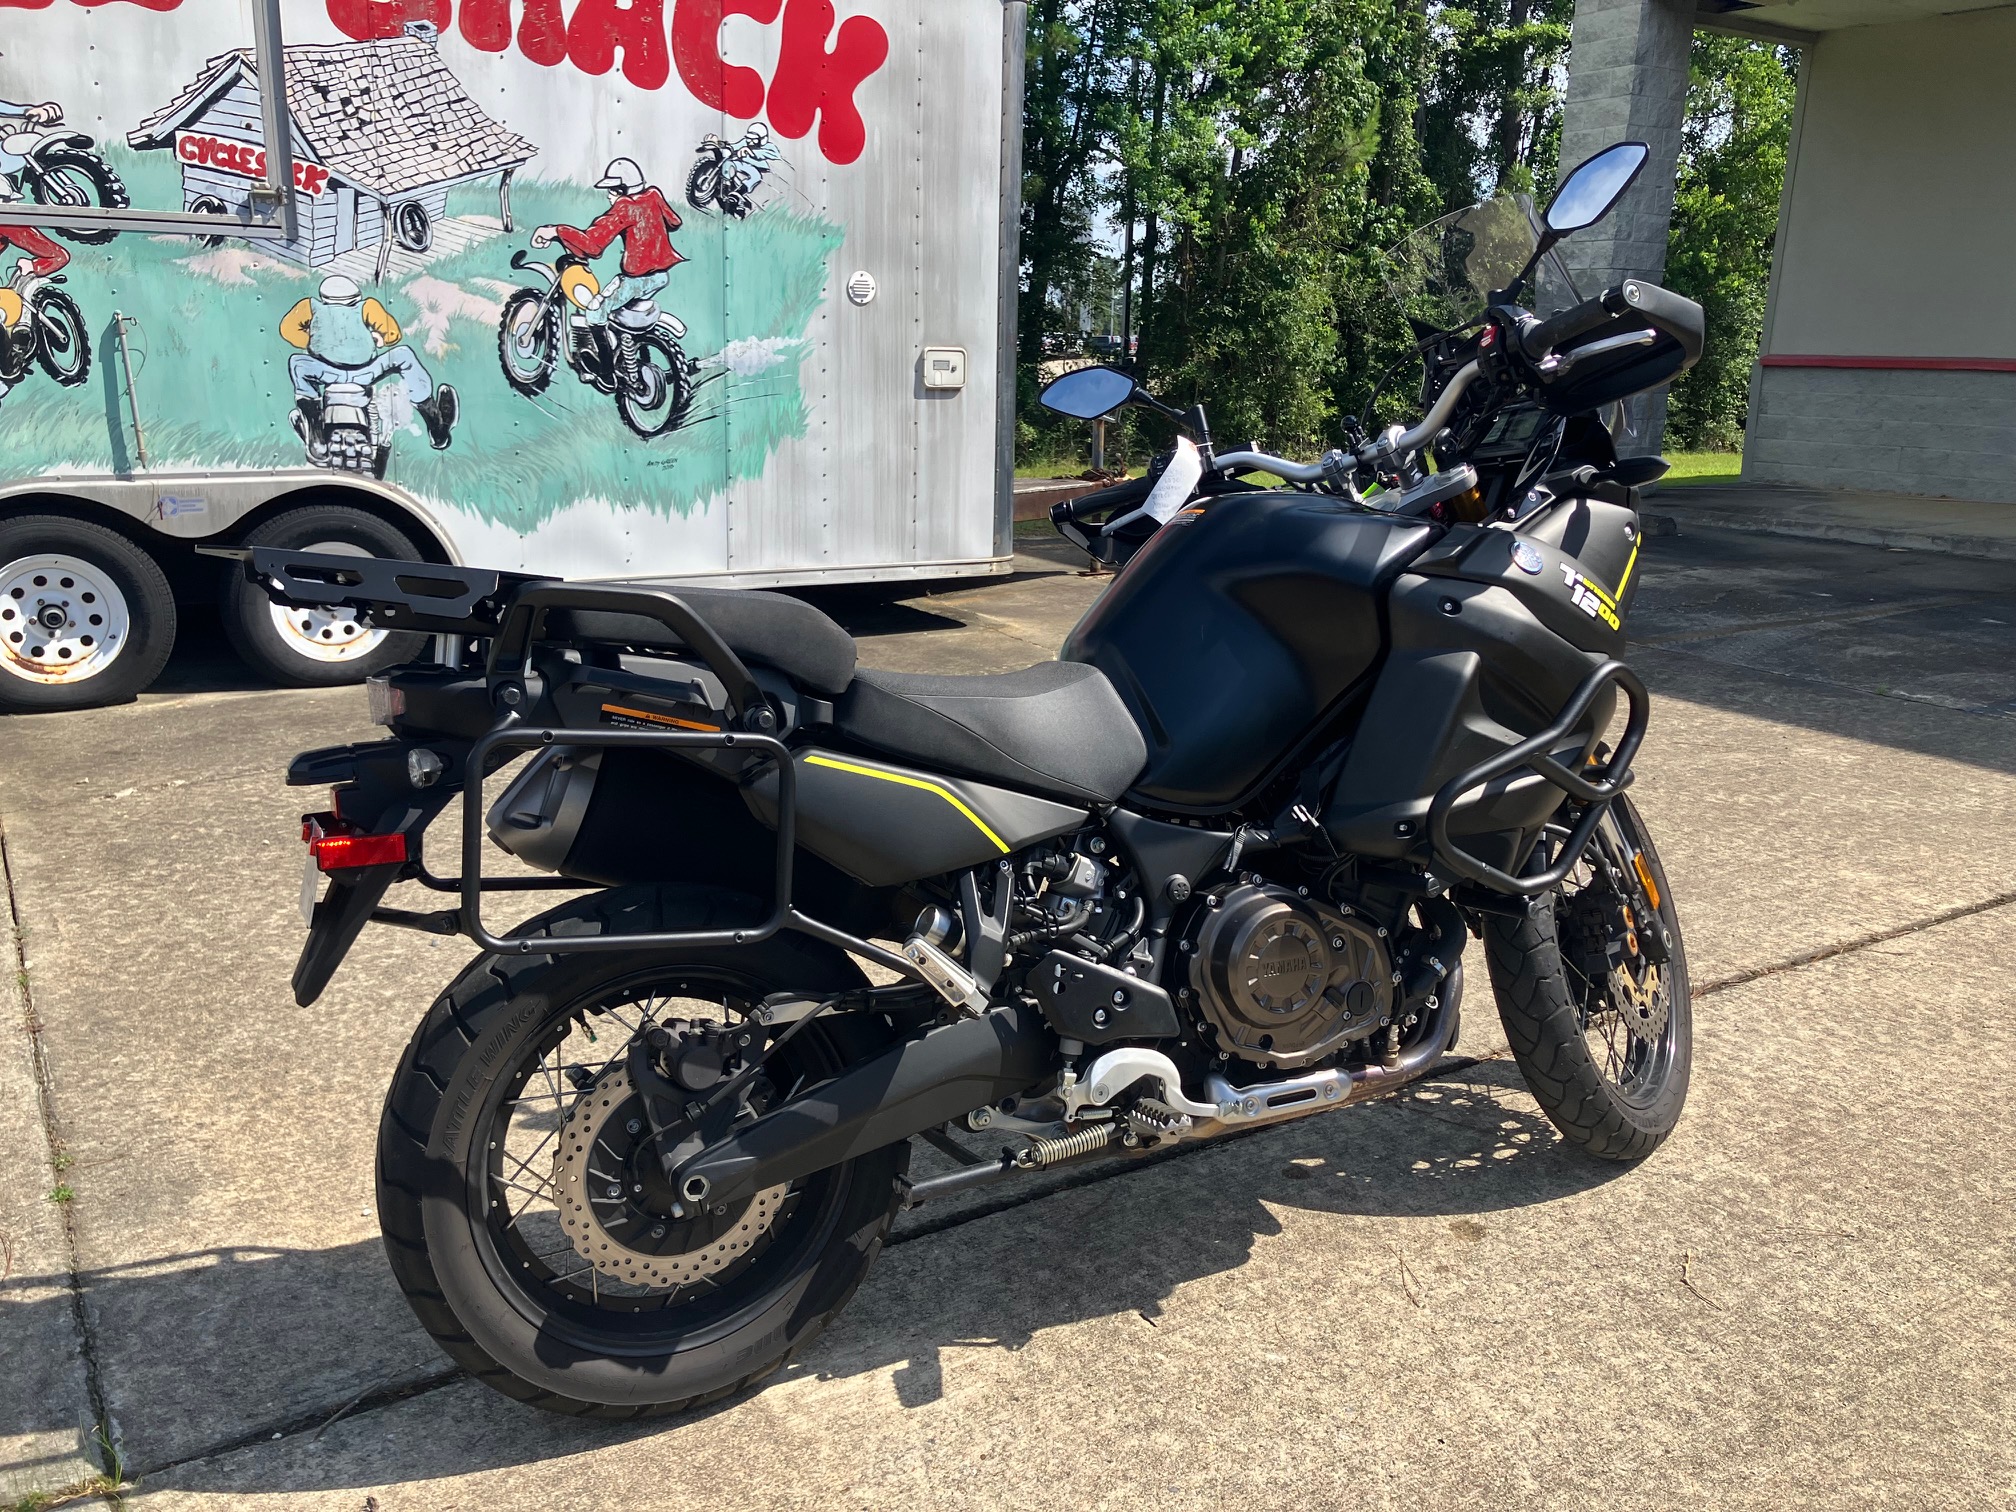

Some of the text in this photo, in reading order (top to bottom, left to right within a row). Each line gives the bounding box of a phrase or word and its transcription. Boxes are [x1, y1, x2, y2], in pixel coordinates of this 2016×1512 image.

[1571, 583, 1621, 631] 1200
[652, 715, 680, 725] WARNING
[1262, 956, 1307, 978] YAMAHA
